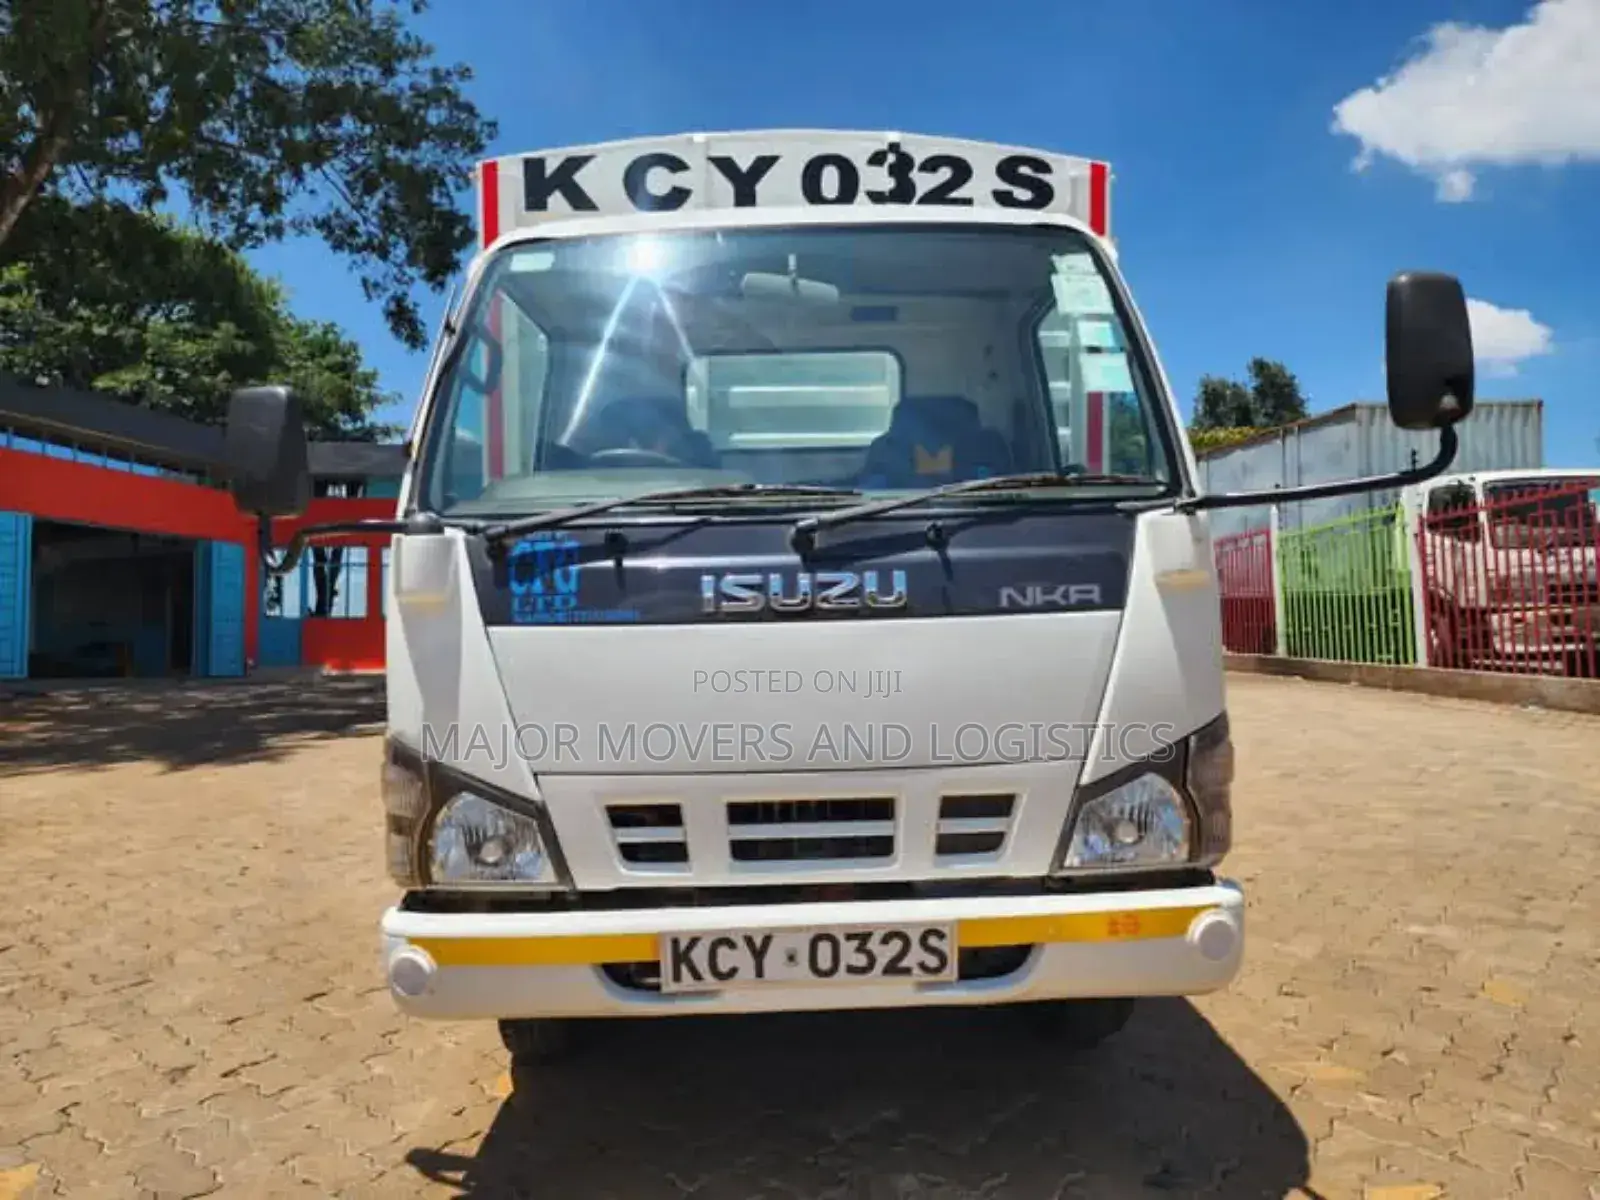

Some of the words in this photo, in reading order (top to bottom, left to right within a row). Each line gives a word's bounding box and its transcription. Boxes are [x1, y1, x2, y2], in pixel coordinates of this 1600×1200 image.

[701, 570, 907, 613] ISUZU
[1001, 584, 1100, 608] NKR
[670, 934, 773, 983] KCY
[808, 928, 949, 978] 032S
